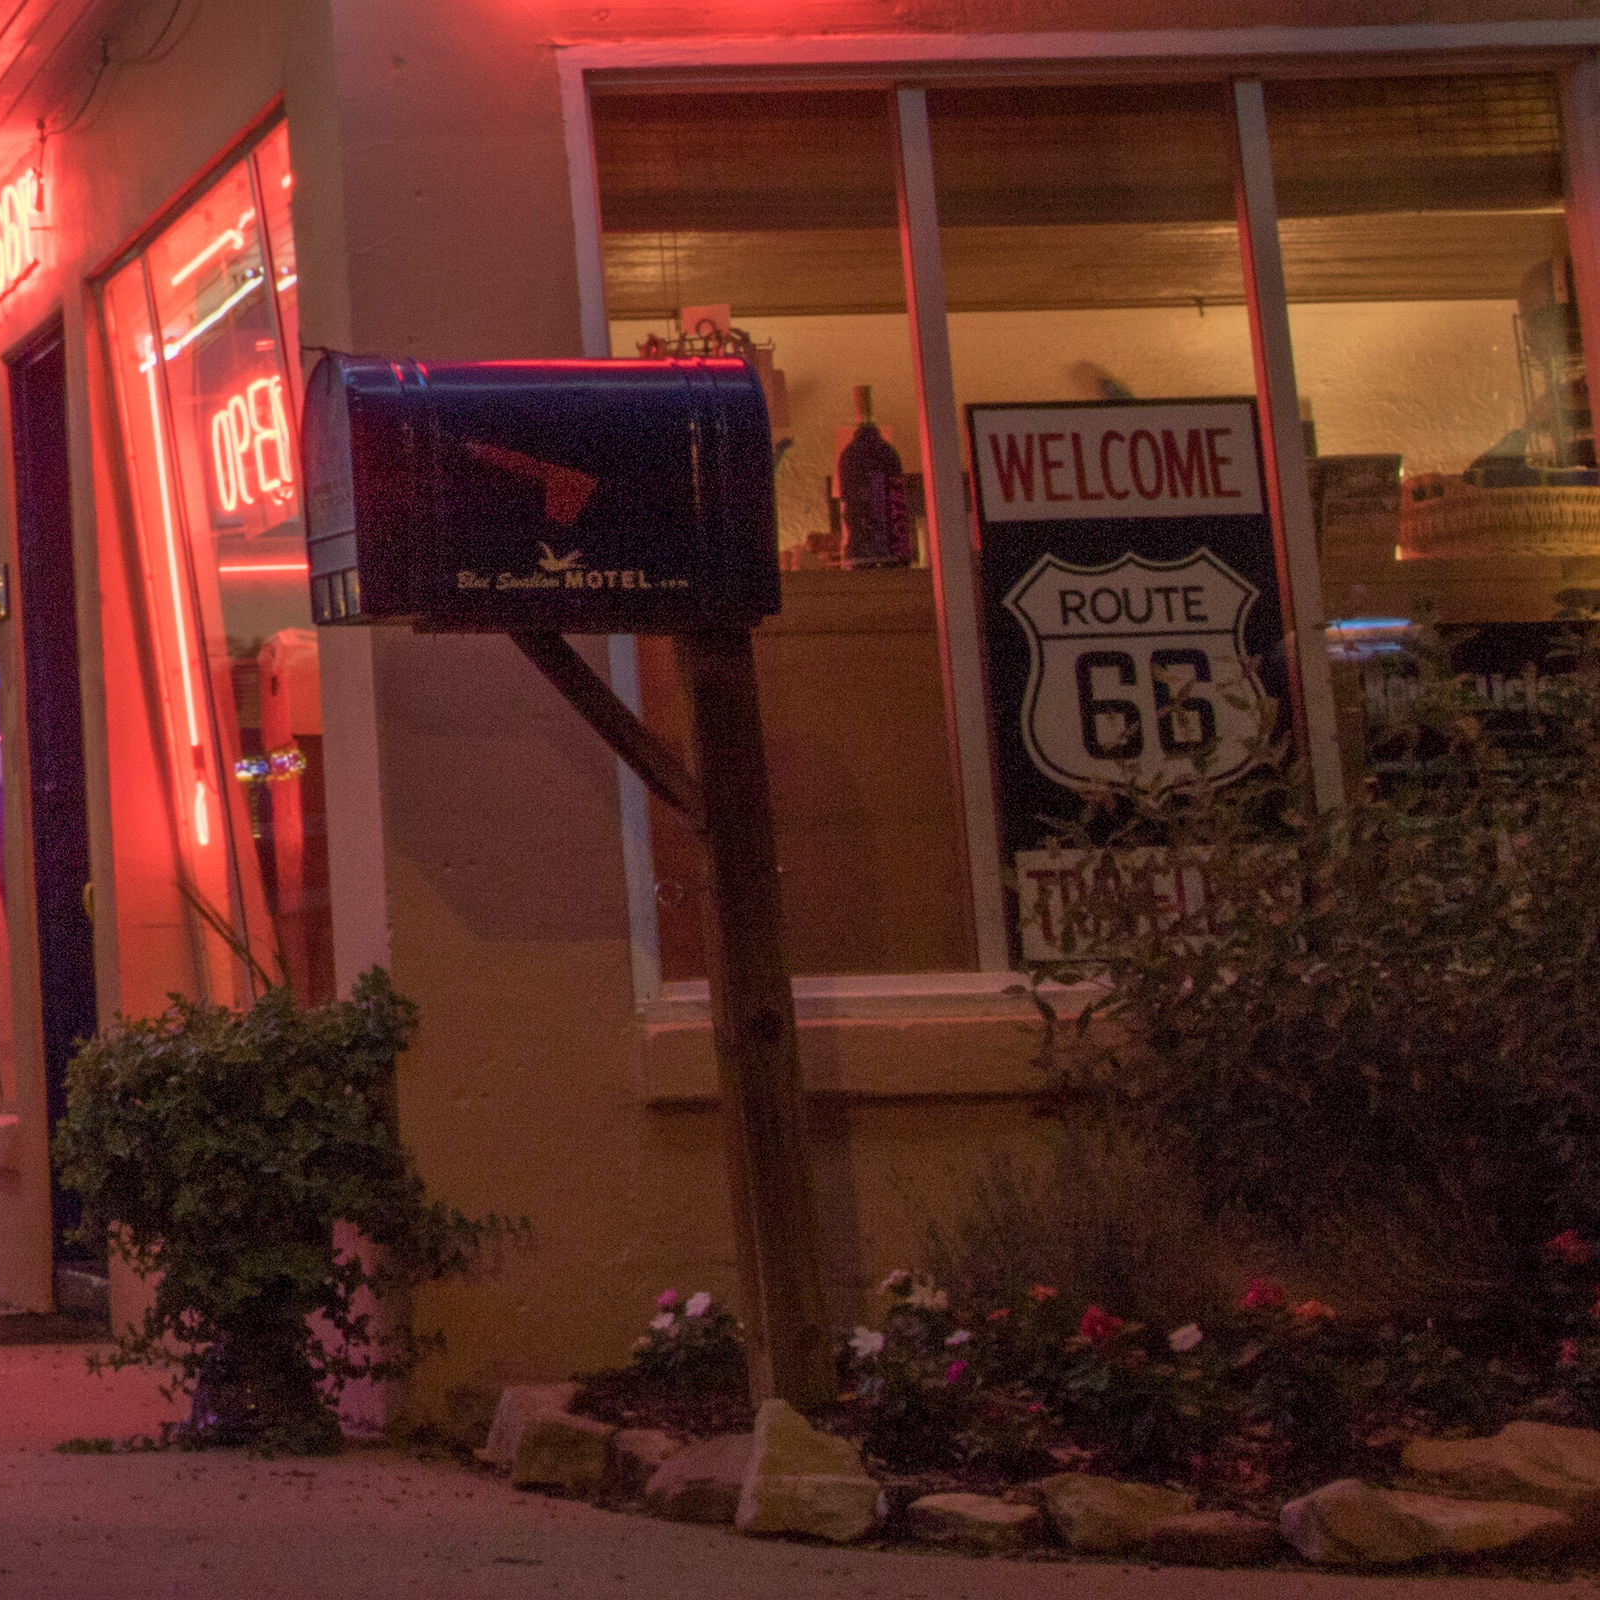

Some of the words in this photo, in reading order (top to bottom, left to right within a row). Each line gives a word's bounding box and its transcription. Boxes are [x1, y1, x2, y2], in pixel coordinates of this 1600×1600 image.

[210, 374, 296, 512] OPEN
[989, 427, 1241, 503] WELCOME
[1058, 586, 1209, 626] ROUTE
[1075, 650, 1218, 761] 66
